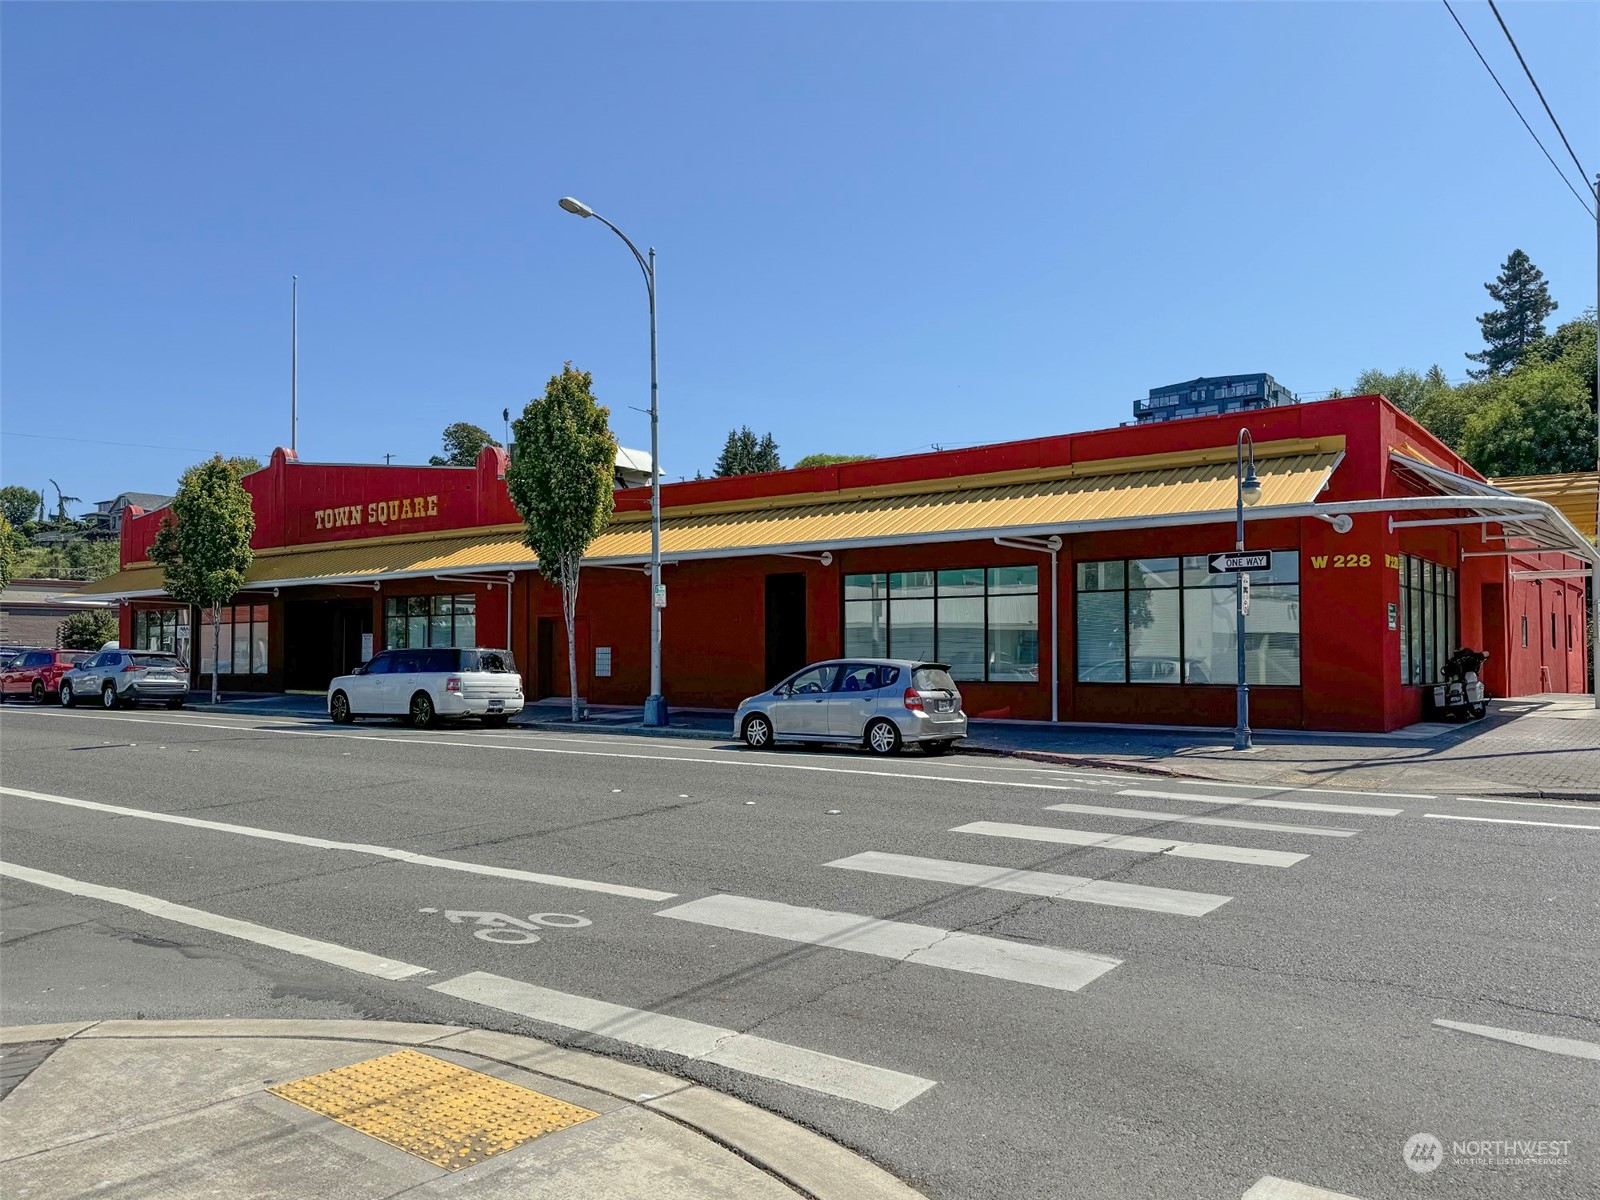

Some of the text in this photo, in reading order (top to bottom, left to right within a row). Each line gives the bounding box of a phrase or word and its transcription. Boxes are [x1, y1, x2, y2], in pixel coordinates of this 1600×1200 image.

[315, 495, 438, 529] TOWN SQUARE
[1226, 556, 1264, 567] ONE WAY
[1311, 554, 1371, 568] W 228
